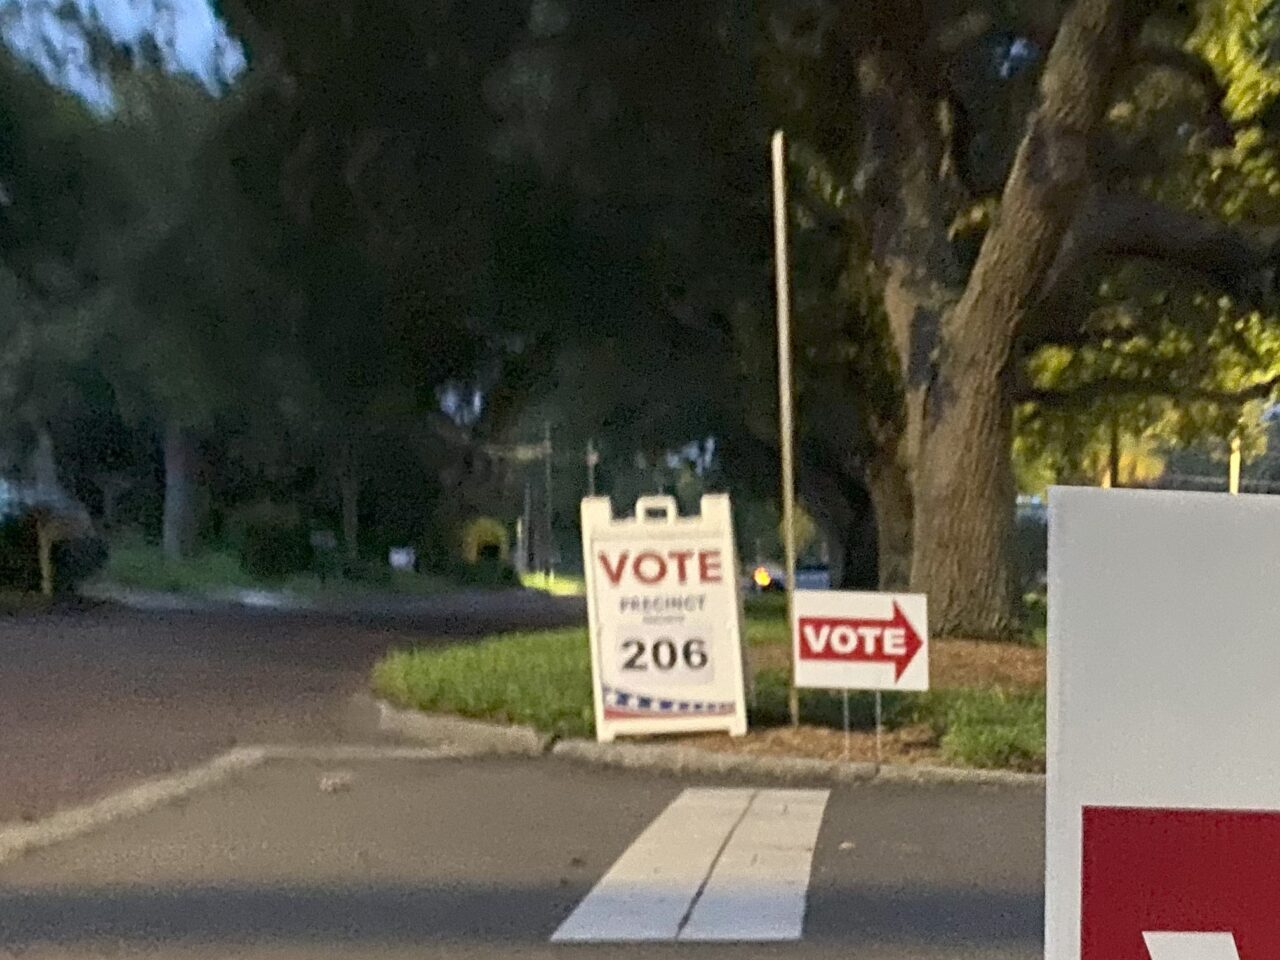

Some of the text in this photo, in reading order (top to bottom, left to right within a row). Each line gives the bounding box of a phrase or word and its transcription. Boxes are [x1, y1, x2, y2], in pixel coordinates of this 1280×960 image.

[598, 551, 723, 586] VOTE
[619, 594, 706, 613] PRECINCT
[621, 638, 708, 671] 206
[803, 626, 907, 655] VOTE
